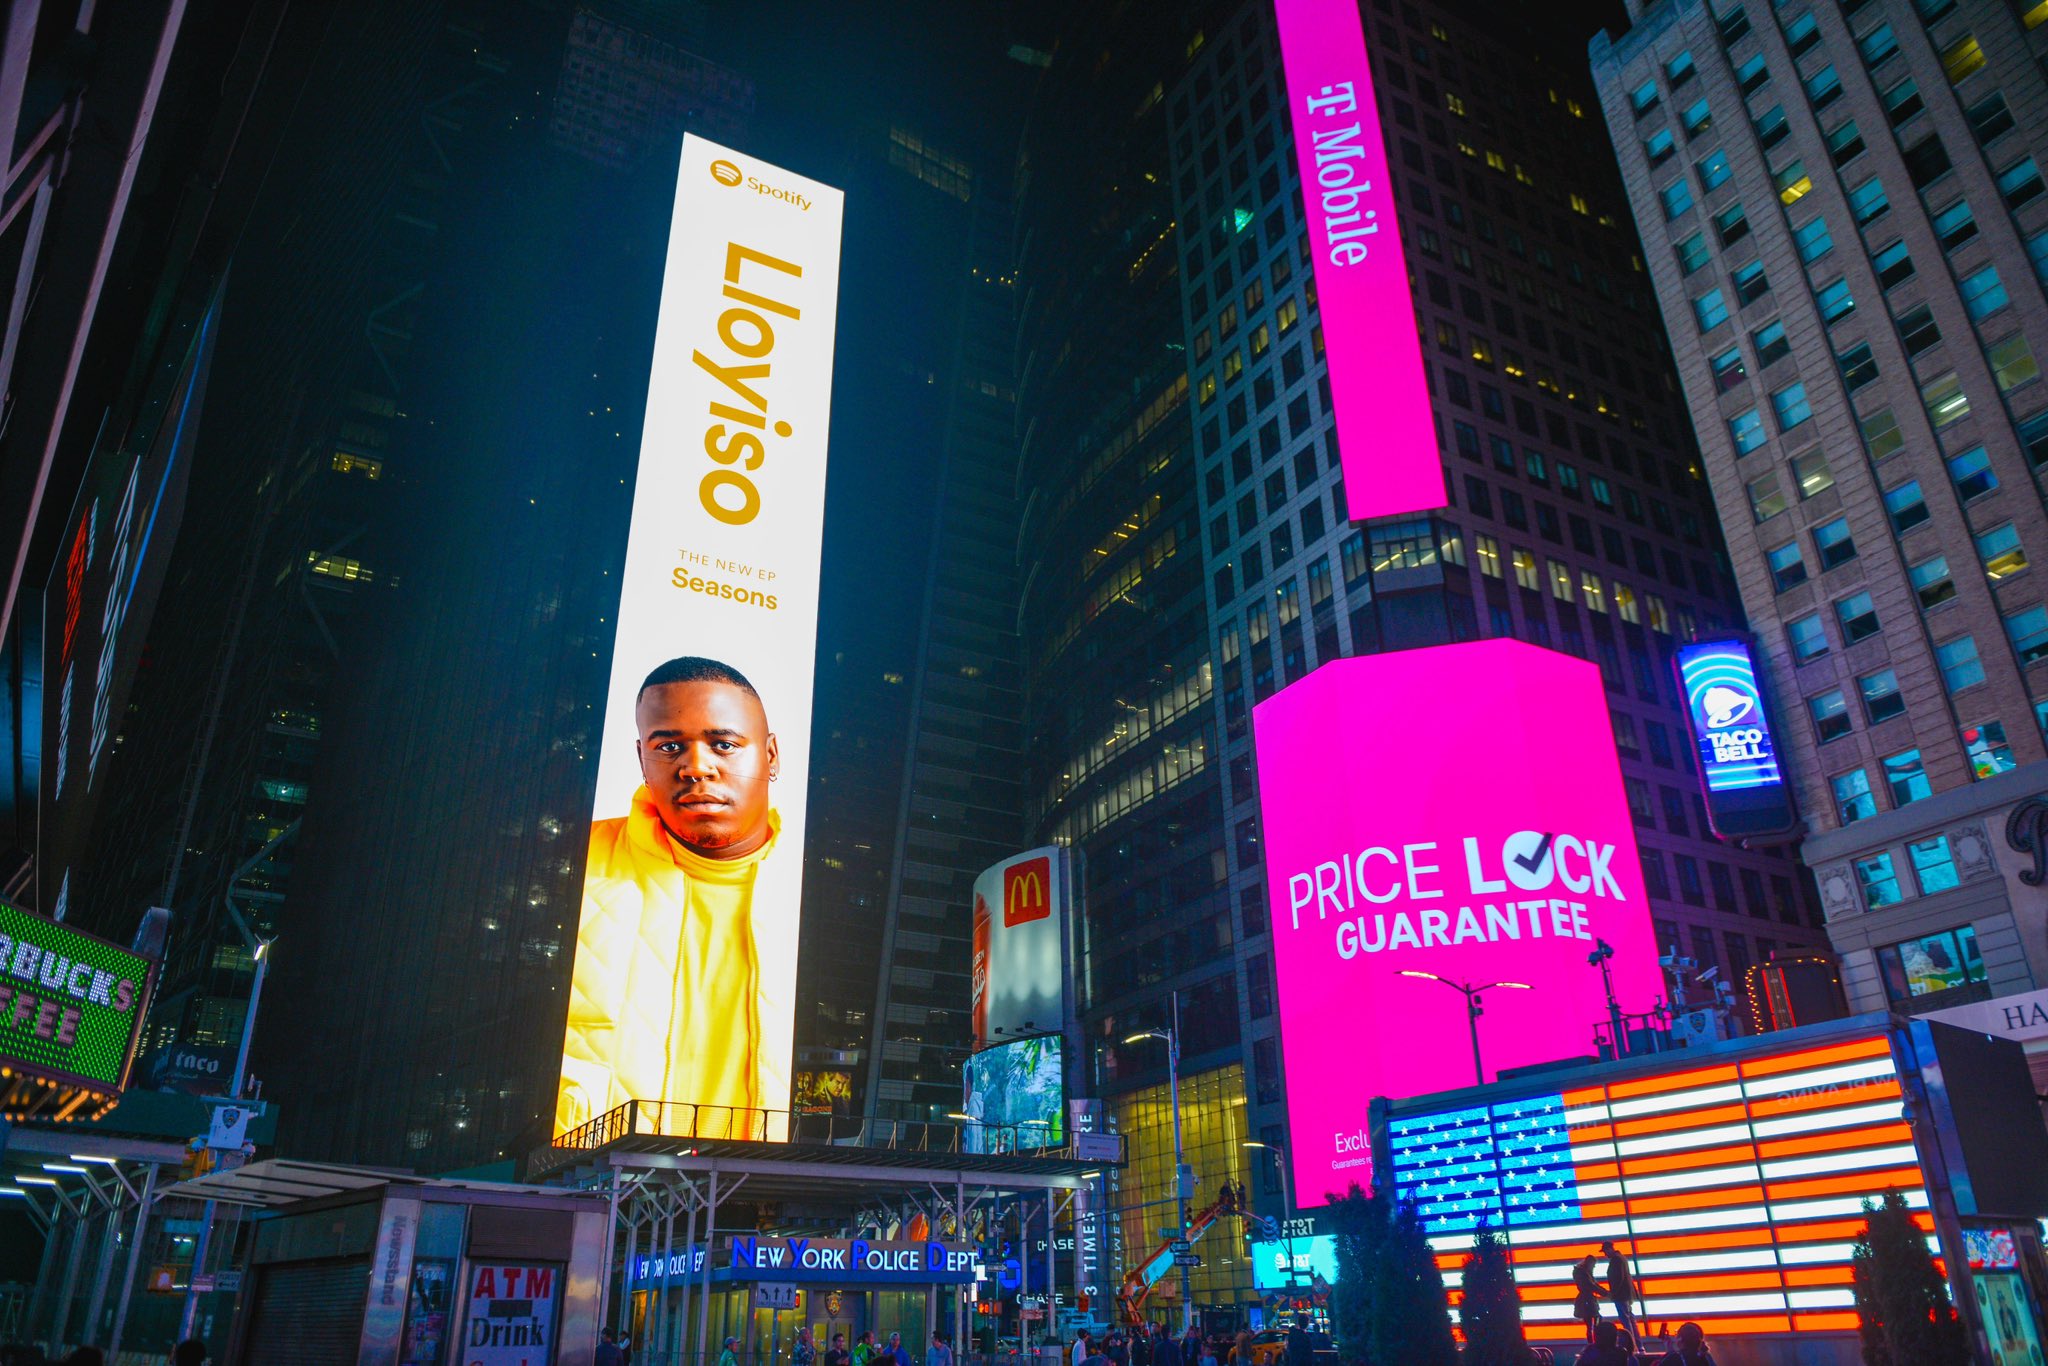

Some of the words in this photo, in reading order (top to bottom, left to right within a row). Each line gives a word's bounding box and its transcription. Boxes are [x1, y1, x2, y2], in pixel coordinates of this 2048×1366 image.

[747, 176, 812, 211] Spotify
[1312, 122, 1378, 266] Mobile
[693, 241, 802, 526] Lloyiso
[678, 548, 709, 566] THE
[716, 558, 752, 576] NEW
[758, 569, 776, 581] EP
[671, 567, 778, 610] Seasons
[1706, 729, 1762, 748] TACO
[1714, 743, 1767, 763] BELL
[1289, 842, 1443, 929] PRICE
[1463, 830, 1626, 902] LOCK
[1336, 899, 1592, 960] GUARANTEE
[1331, 1157, 1366, 1170] Guarantees
[732, 1236, 785, 1268] NEW
[786, 1239, 845, 1269] YORK
[851, 1240, 919, 1270] POLICE
[927, 1241, 979, 1272] DEPT
[1082, 1211, 1097, 1273] TIMES
[670, 1253, 687, 1276] OLICE
[474, 1267, 551, 1299] ATM
[1016, 1293, 1064, 1304] CHAE
[1083, 1286, 1098, 1296] 3
[469, 1317, 544, 1348] Drink
